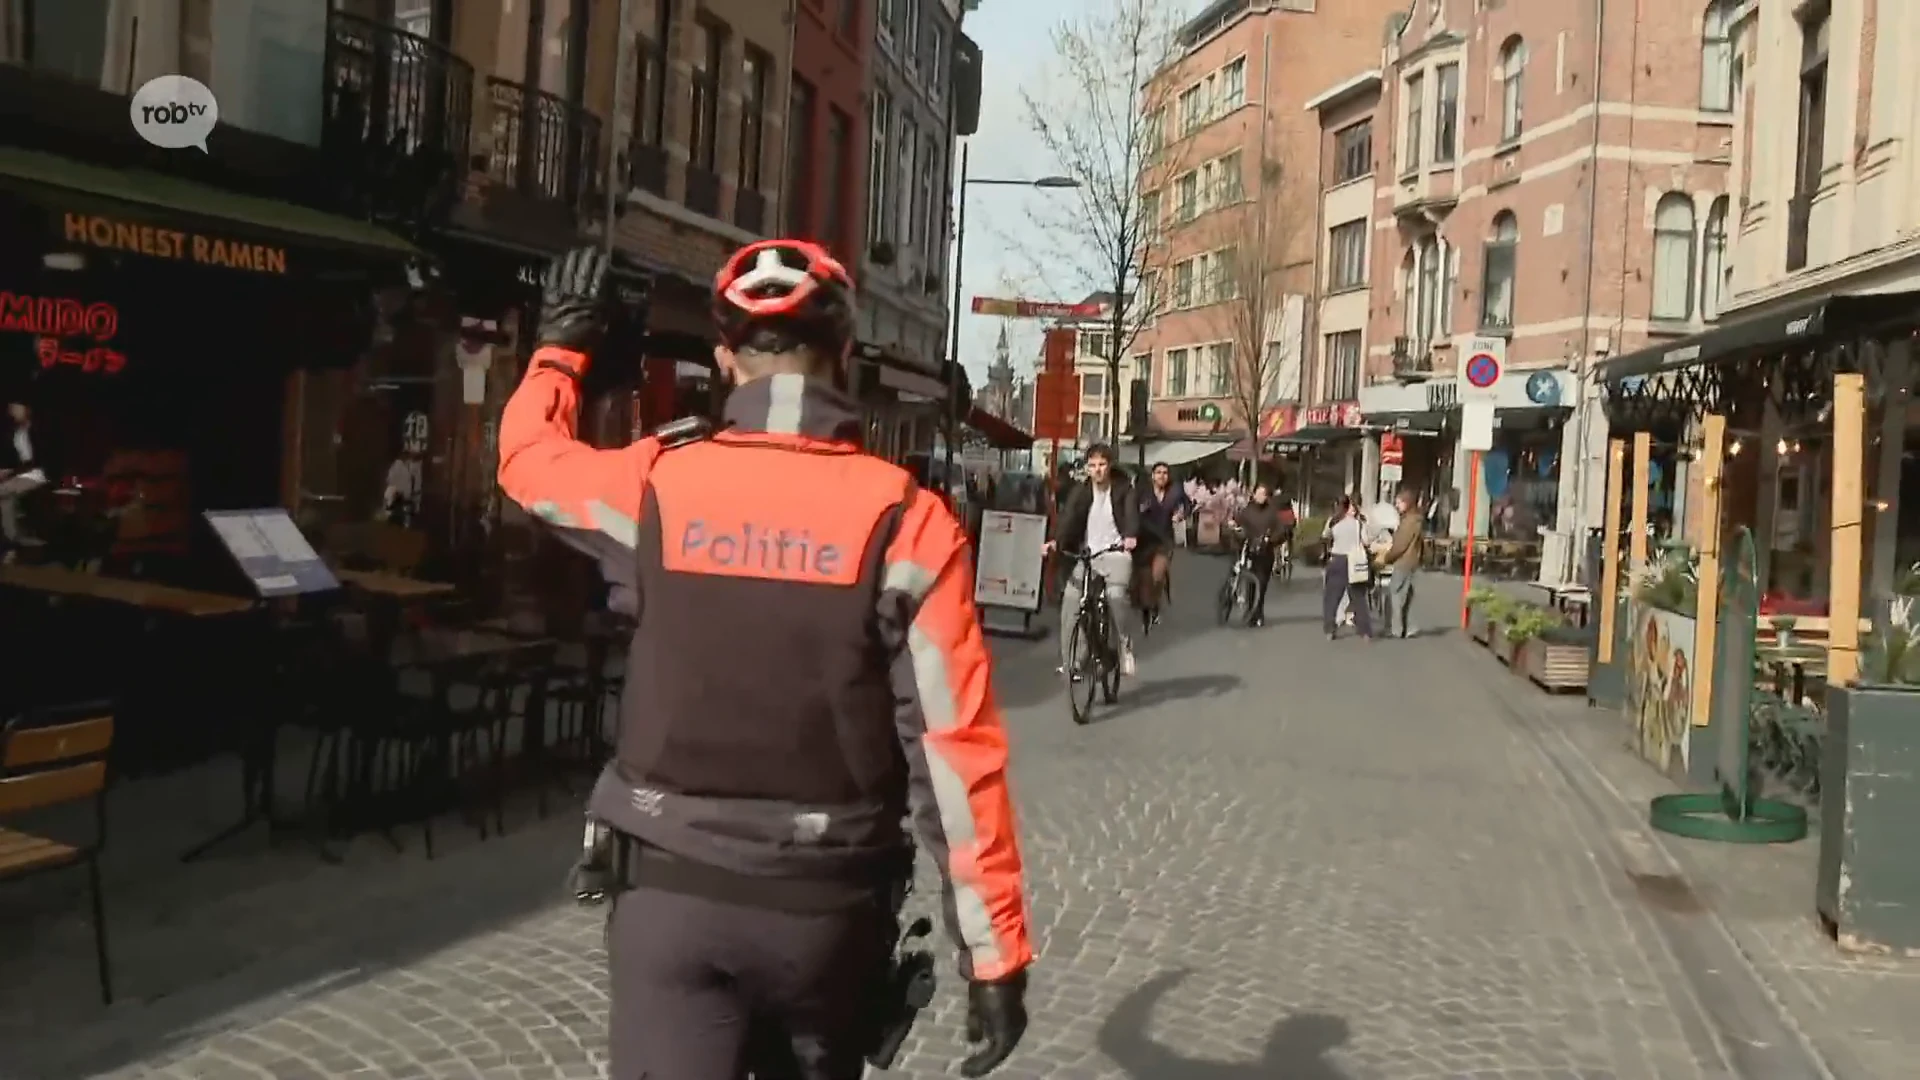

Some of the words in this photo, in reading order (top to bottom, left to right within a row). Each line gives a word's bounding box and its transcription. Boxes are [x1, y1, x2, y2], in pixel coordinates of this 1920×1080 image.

[64, 212, 186, 258] HONEST
[193, 234, 286, 273] RAMEN
[0, 291, 118, 341] MIDO
[682, 520, 840, 576] Politie
